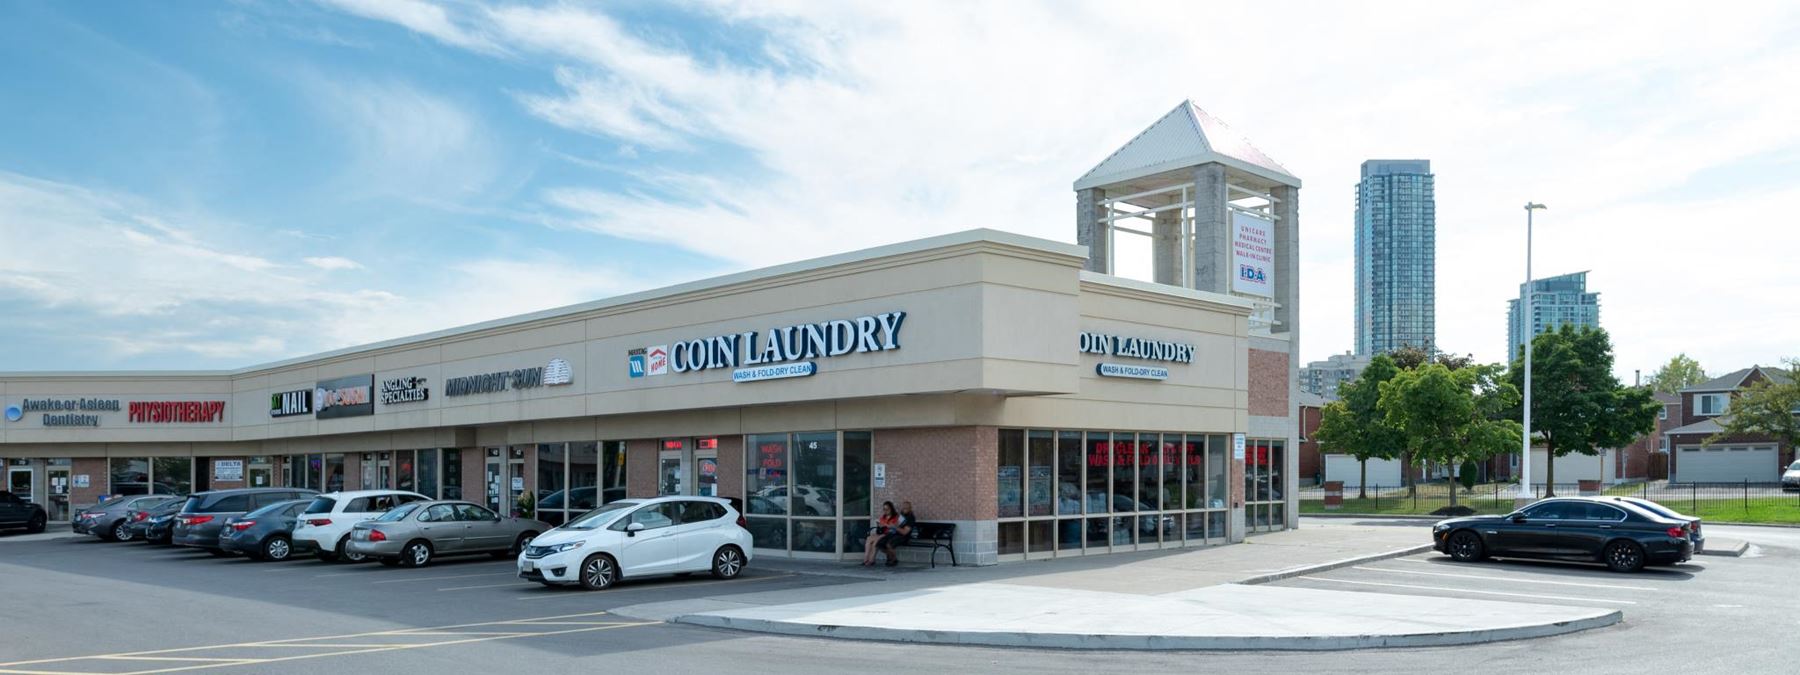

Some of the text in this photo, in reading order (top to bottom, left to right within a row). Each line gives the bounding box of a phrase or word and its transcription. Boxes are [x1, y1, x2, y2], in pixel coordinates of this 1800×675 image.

[1239, 233, 1267, 244] PHARMACY
[670, 312, 906, 373] COIN LAUNDRY
[1079, 331, 1198, 363] OIN LAUNDRY
[651, 357, 666, 372] HOME
[1102, 365, 1119, 373] WASH
[1125, 368, 1150, 376] FOLD-DRY
[1150, 369, 1168, 377] CLEAN
[734, 371, 751, 380] WASH
[758, 367, 788, 377] FOLD-DRY
[789, 365, 811, 375] CLEAN
[381, 377, 416, 392] ANGLING
[445, 367, 543, 396] MIDNIGHT SUN
[282, 390, 308, 414] NAIL
[381, 388, 428, 404] SPECIALTIES
[22, 398, 120, 411] Awake or Asleep
[128, 401, 225, 423] PHYSIOTHERAPY
[43, 413, 99, 427] Dentistry
[1089, 453, 1113, 465] WAS
[1127, 454, 1150, 465] FLD
